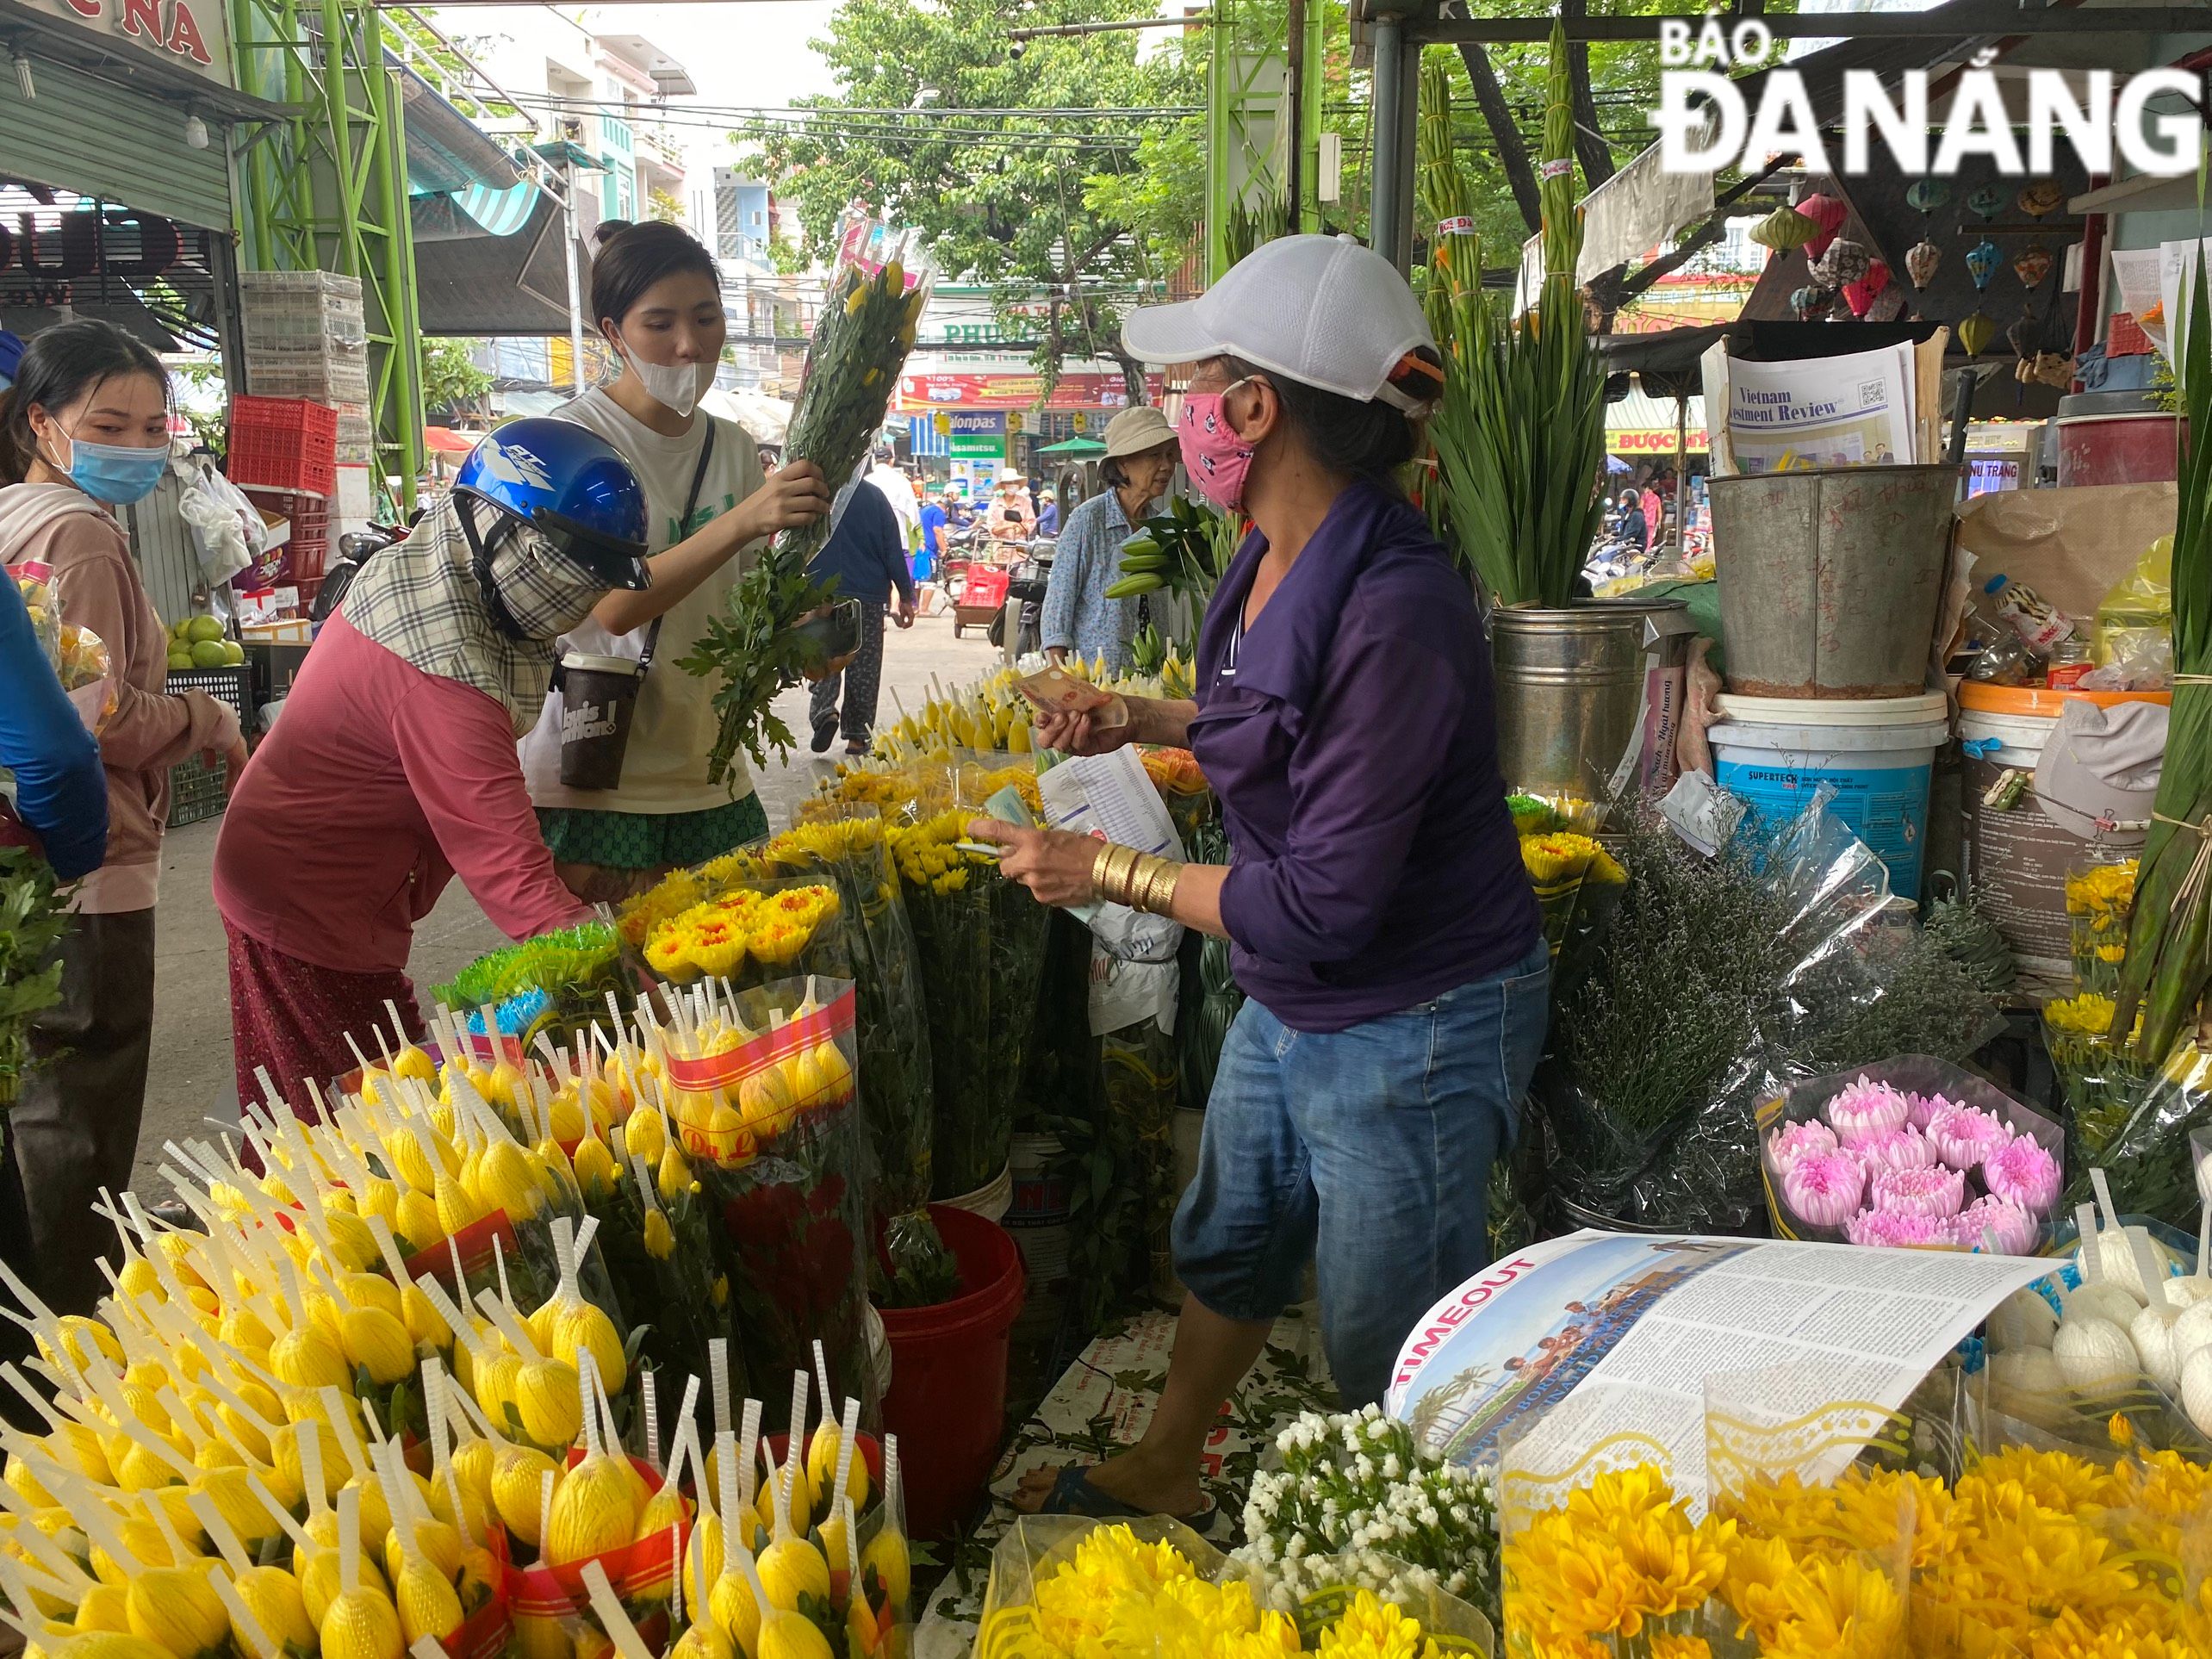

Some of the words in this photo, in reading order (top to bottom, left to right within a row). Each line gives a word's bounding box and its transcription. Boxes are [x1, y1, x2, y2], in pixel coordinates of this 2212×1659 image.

[1740, 387, 1792, 405] Vietnam
[1778, 401, 1838, 421] Review
[950, 412, 997, 431] alonpas
[1986, 465, 2017, 478] TRANG
[1393, 1258, 1536, 1391] TIMEOUT
[1595, 1293, 1658, 1354] FOREIGN
[1516, 1351, 1579, 1412] BORDER
